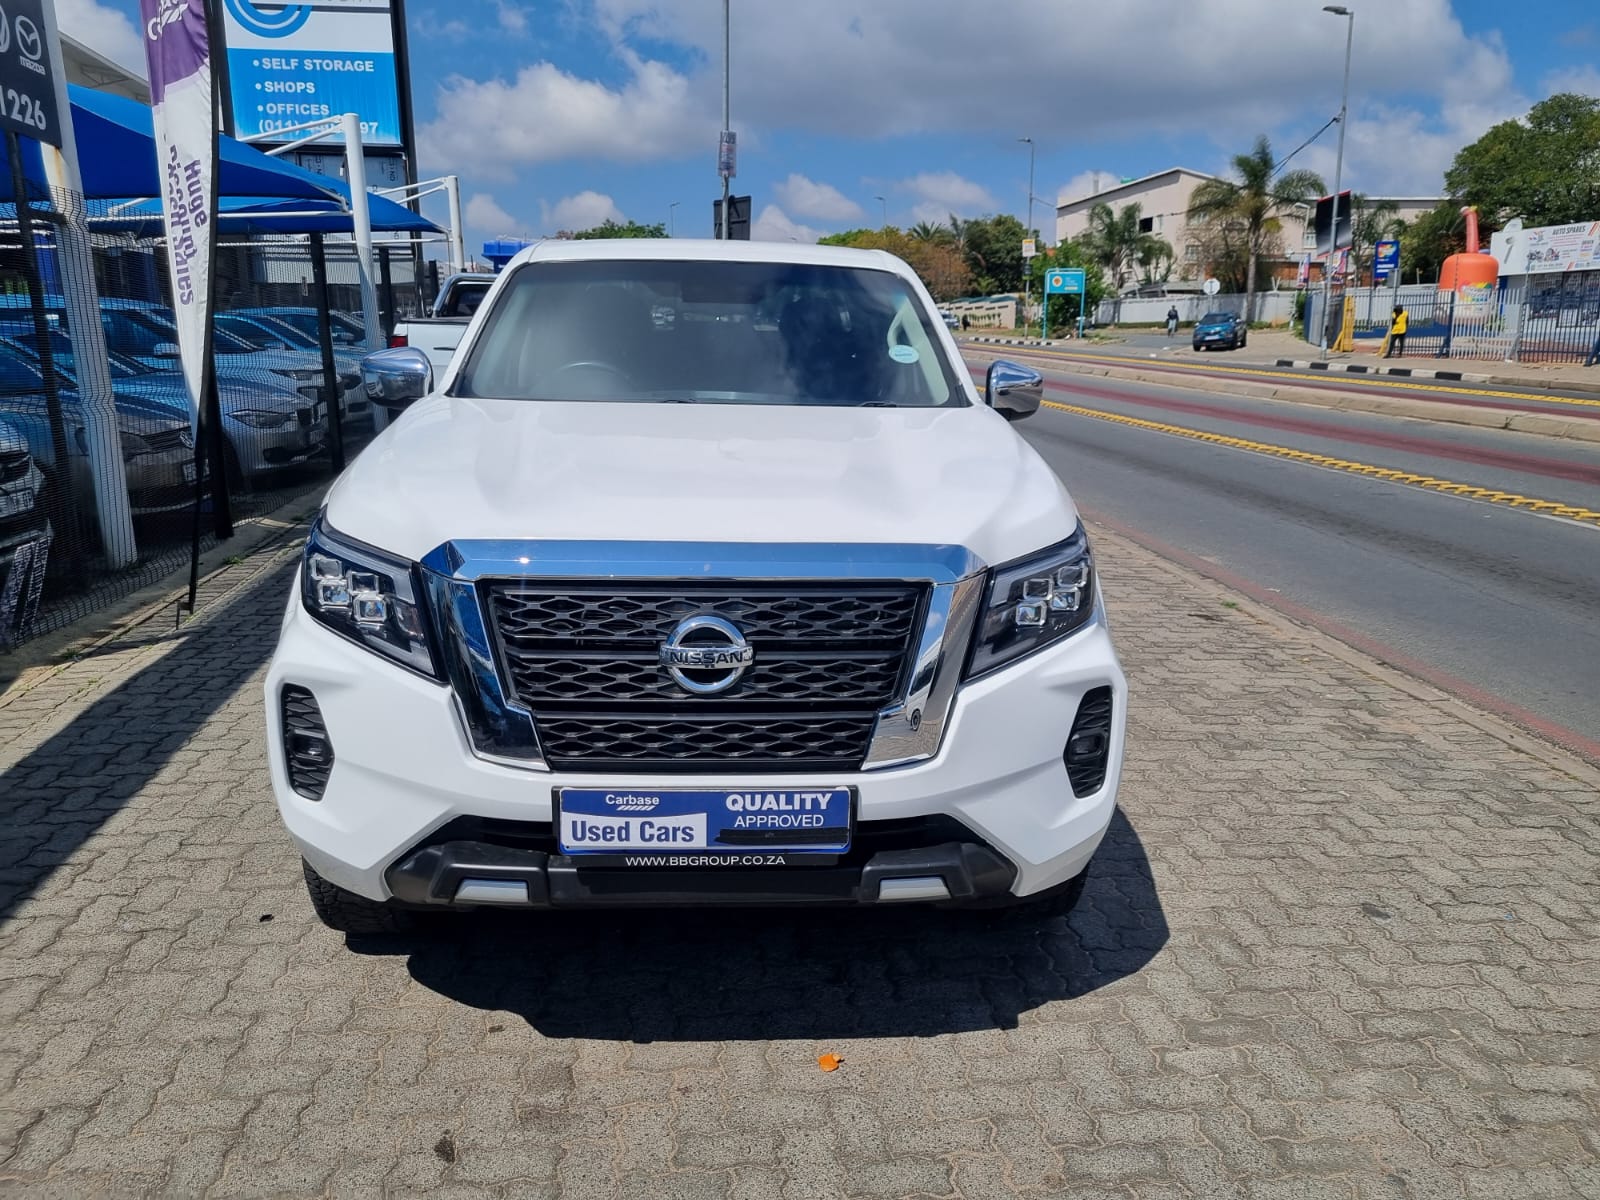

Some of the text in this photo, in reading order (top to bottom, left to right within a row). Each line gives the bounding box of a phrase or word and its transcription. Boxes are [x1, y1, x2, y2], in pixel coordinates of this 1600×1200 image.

[262, 58, 375, 72] SELF STORAGE
[264, 81, 316, 94] SHOPS
[266, 103, 330, 115] OFFICES
[184, 159, 208, 228] Huge
[671, 650, 743, 664] NISSAN
[605, 794, 660, 805] Carbase
[725, 793, 833, 812] QUALITY
[734, 814, 825, 828] APPROVED
[571, 820, 695, 842] Used Cars
[625, 855, 786, 866] WWW.BBGROUP.CO.ZA
